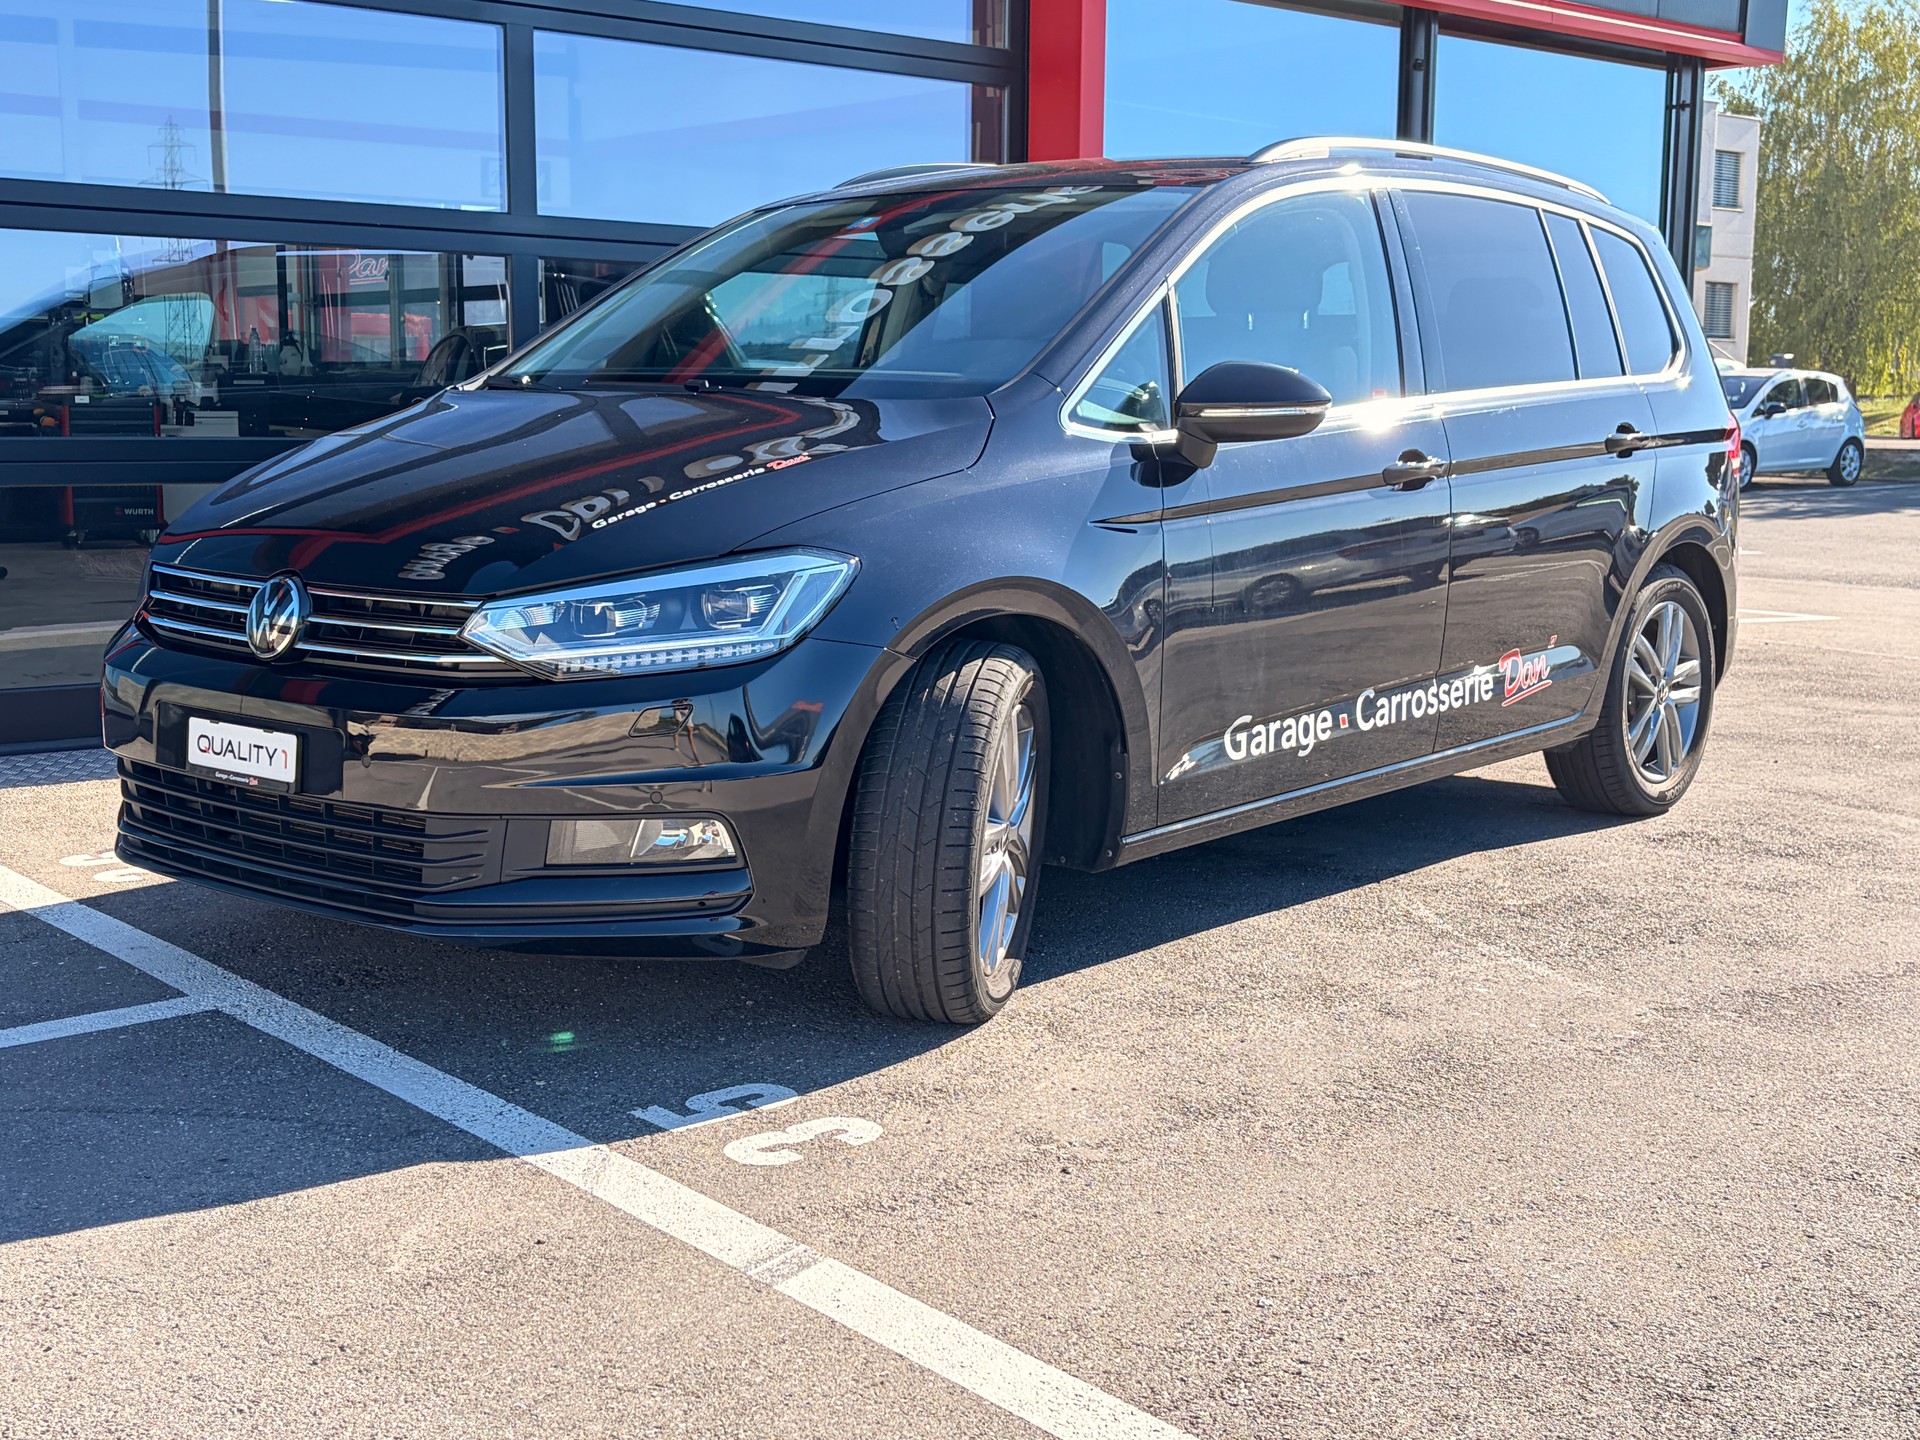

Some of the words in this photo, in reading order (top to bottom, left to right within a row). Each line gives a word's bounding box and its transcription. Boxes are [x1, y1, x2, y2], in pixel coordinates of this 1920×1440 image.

[592, 501, 657, 529] Garage
[669, 466, 766, 500] Carrosserie
[1223, 715, 1333, 759] Garage
[1356, 670, 1494, 731] Carrosserie
[197, 734, 278, 767] QUALITY
[281, 749, 288, 769] 1
